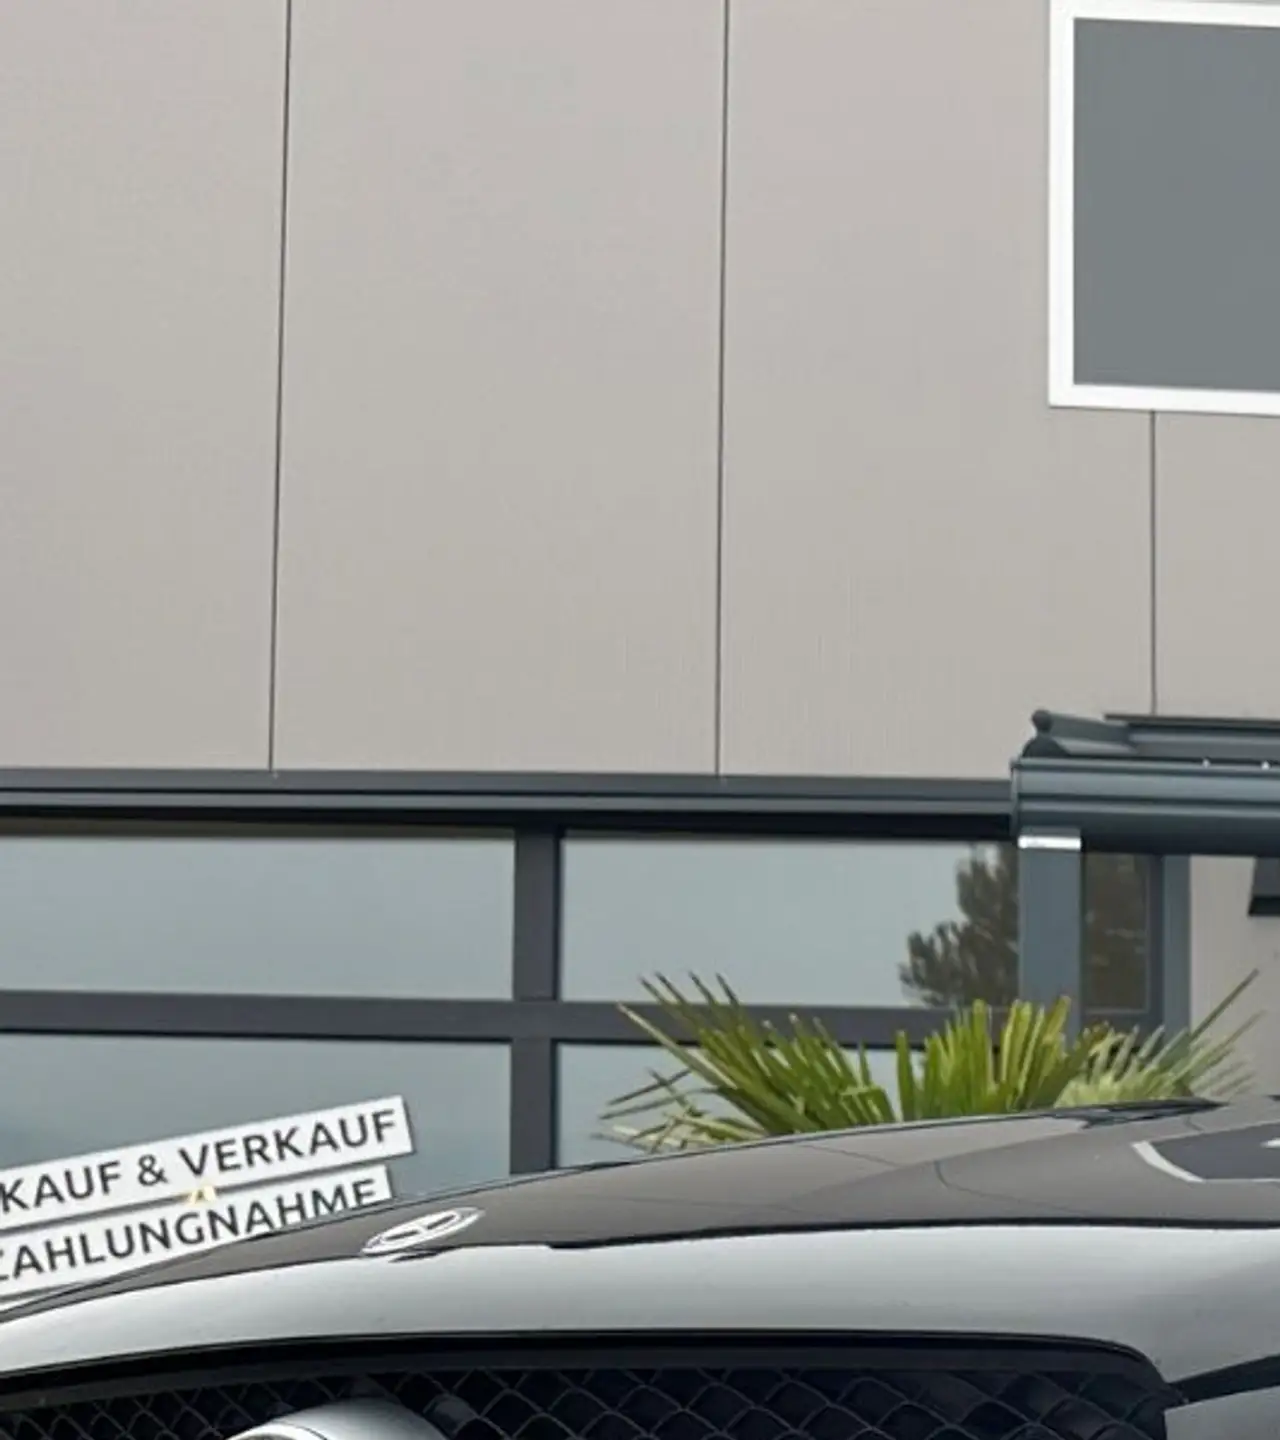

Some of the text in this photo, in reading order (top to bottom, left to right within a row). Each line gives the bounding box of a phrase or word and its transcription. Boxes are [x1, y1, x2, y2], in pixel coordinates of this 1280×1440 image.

[137, 1153, 169, 1188] &
[178, 1108, 398, 1178] VERKAUF
[0, 1178, 376, 1281] AHLUNGNAHME
